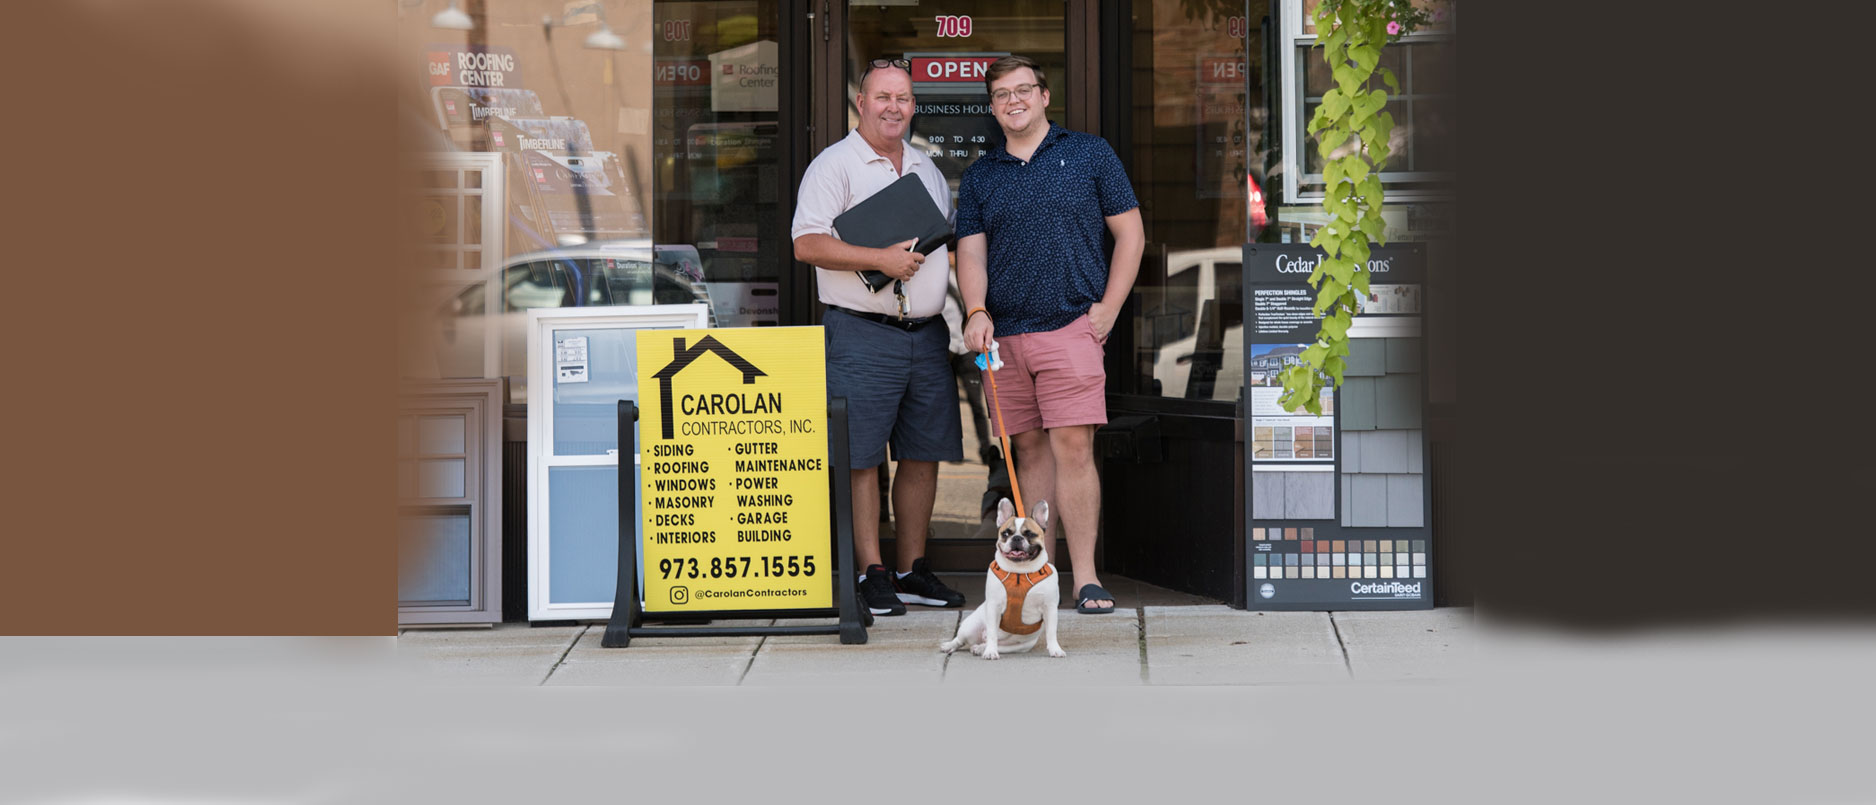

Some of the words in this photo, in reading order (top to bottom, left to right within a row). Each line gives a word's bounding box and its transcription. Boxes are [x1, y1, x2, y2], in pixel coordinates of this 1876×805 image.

[935, 15, 972, 38] 709
[429, 61, 450, 76] GAF
[457, 52, 515, 72] ROOFING
[927, 61, 988, 78] OPEN
[460, 70, 504, 87] CENTER
[739, 77, 775, 88] Center
[914, 104, 960, 114] BUSINESS
[516, 134, 565, 151] TIMBERLINE
[953, 135, 963, 143] TO
[1275, 254, 1314, 273] Cedar
[681, 392, 782, 416] CAROLAN
[681, 420, 786, 436] CONTRACTORS,
[790, 419, 816, 434] INC.
[654, 444, 694, 457] SIDING
[735, 442, 778, 455] GUTTER
[654, 461, 709, 474] ROOFING
[735, 458, 822, 472] MAINTENANCE
[655, 478, 716, 491] WINDOWS
[736, 477, 778, 490] POWER
[655, 496, 714, 509] MASONRY
[737, 494, 793, 507] WASHING
[656, 514, 695, 526] DECKS
[737, 511, 788, 524] GARAGE
[657, 531, 716, 544] INTERIORS
[737, 529, 791, 542] BUILDING
[659, 555, 816, 580] 973.857.1555
[695, 588, 807, 599] @CarolanContractors
[1351, 581, 1421, 594] CertainTeed
